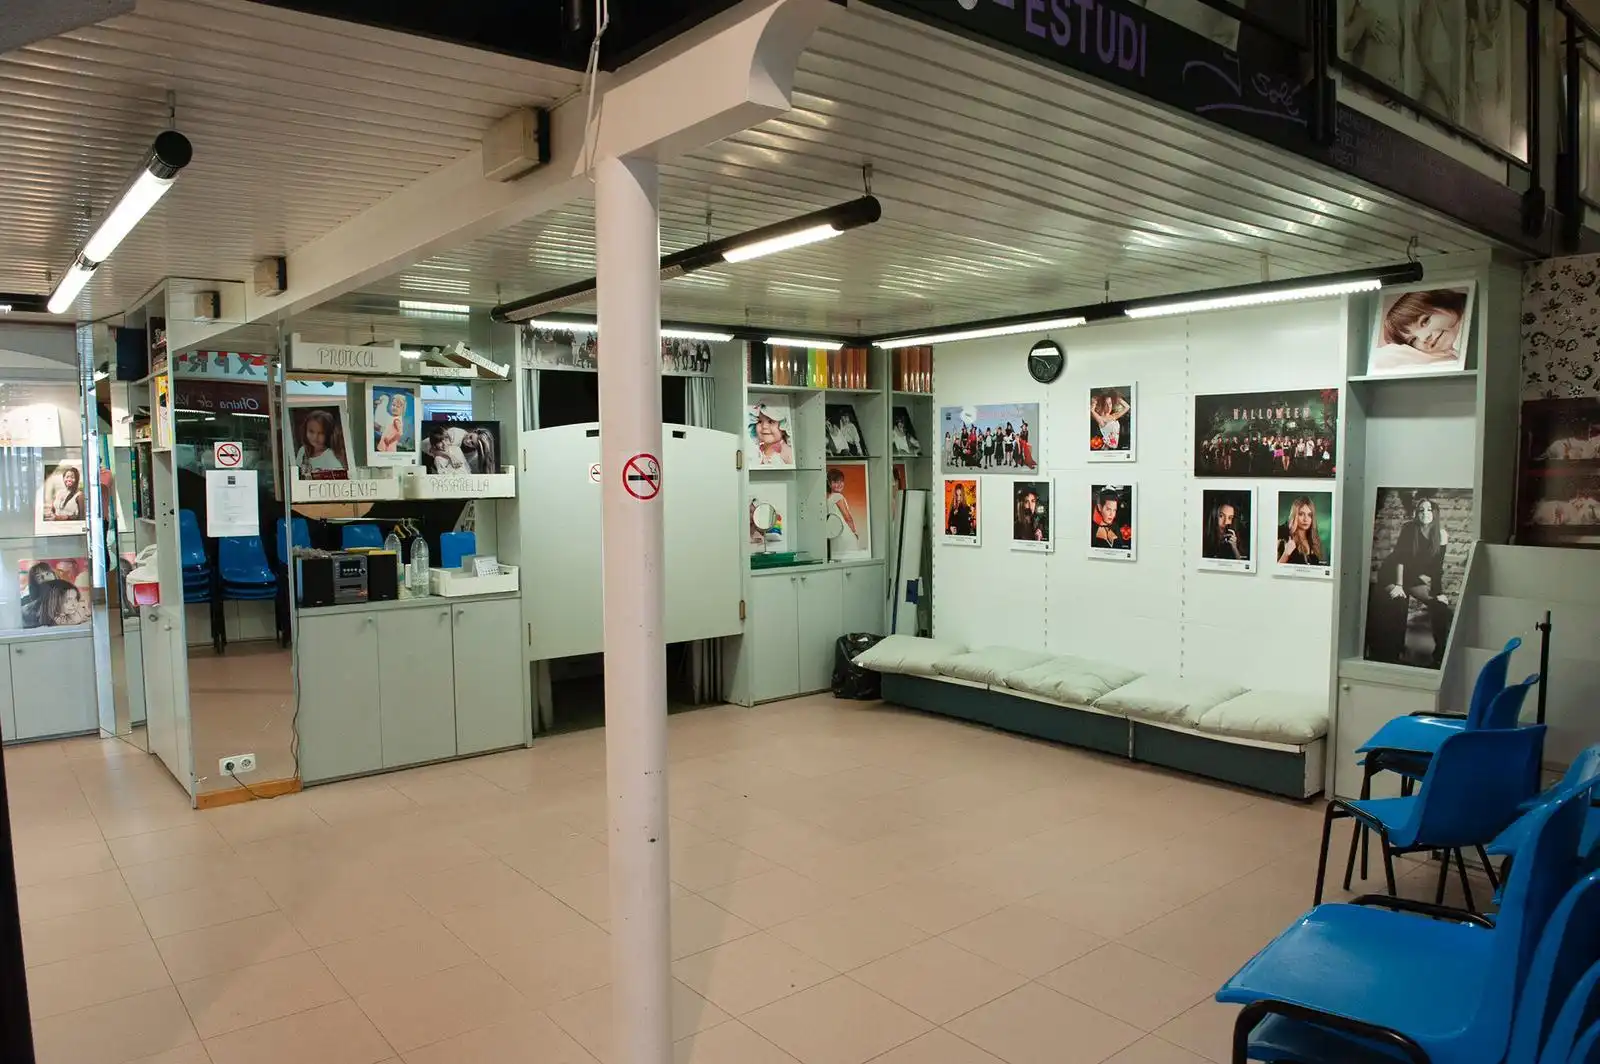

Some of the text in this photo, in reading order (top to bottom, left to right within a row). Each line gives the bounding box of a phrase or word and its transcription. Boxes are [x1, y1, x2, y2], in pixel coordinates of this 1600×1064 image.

[1025, 0, 1147, 77] ESTUDI
[316, 347, 378, 368] PROTOCOL
[1233, 407, 1310, 420] HALLOWEEN
